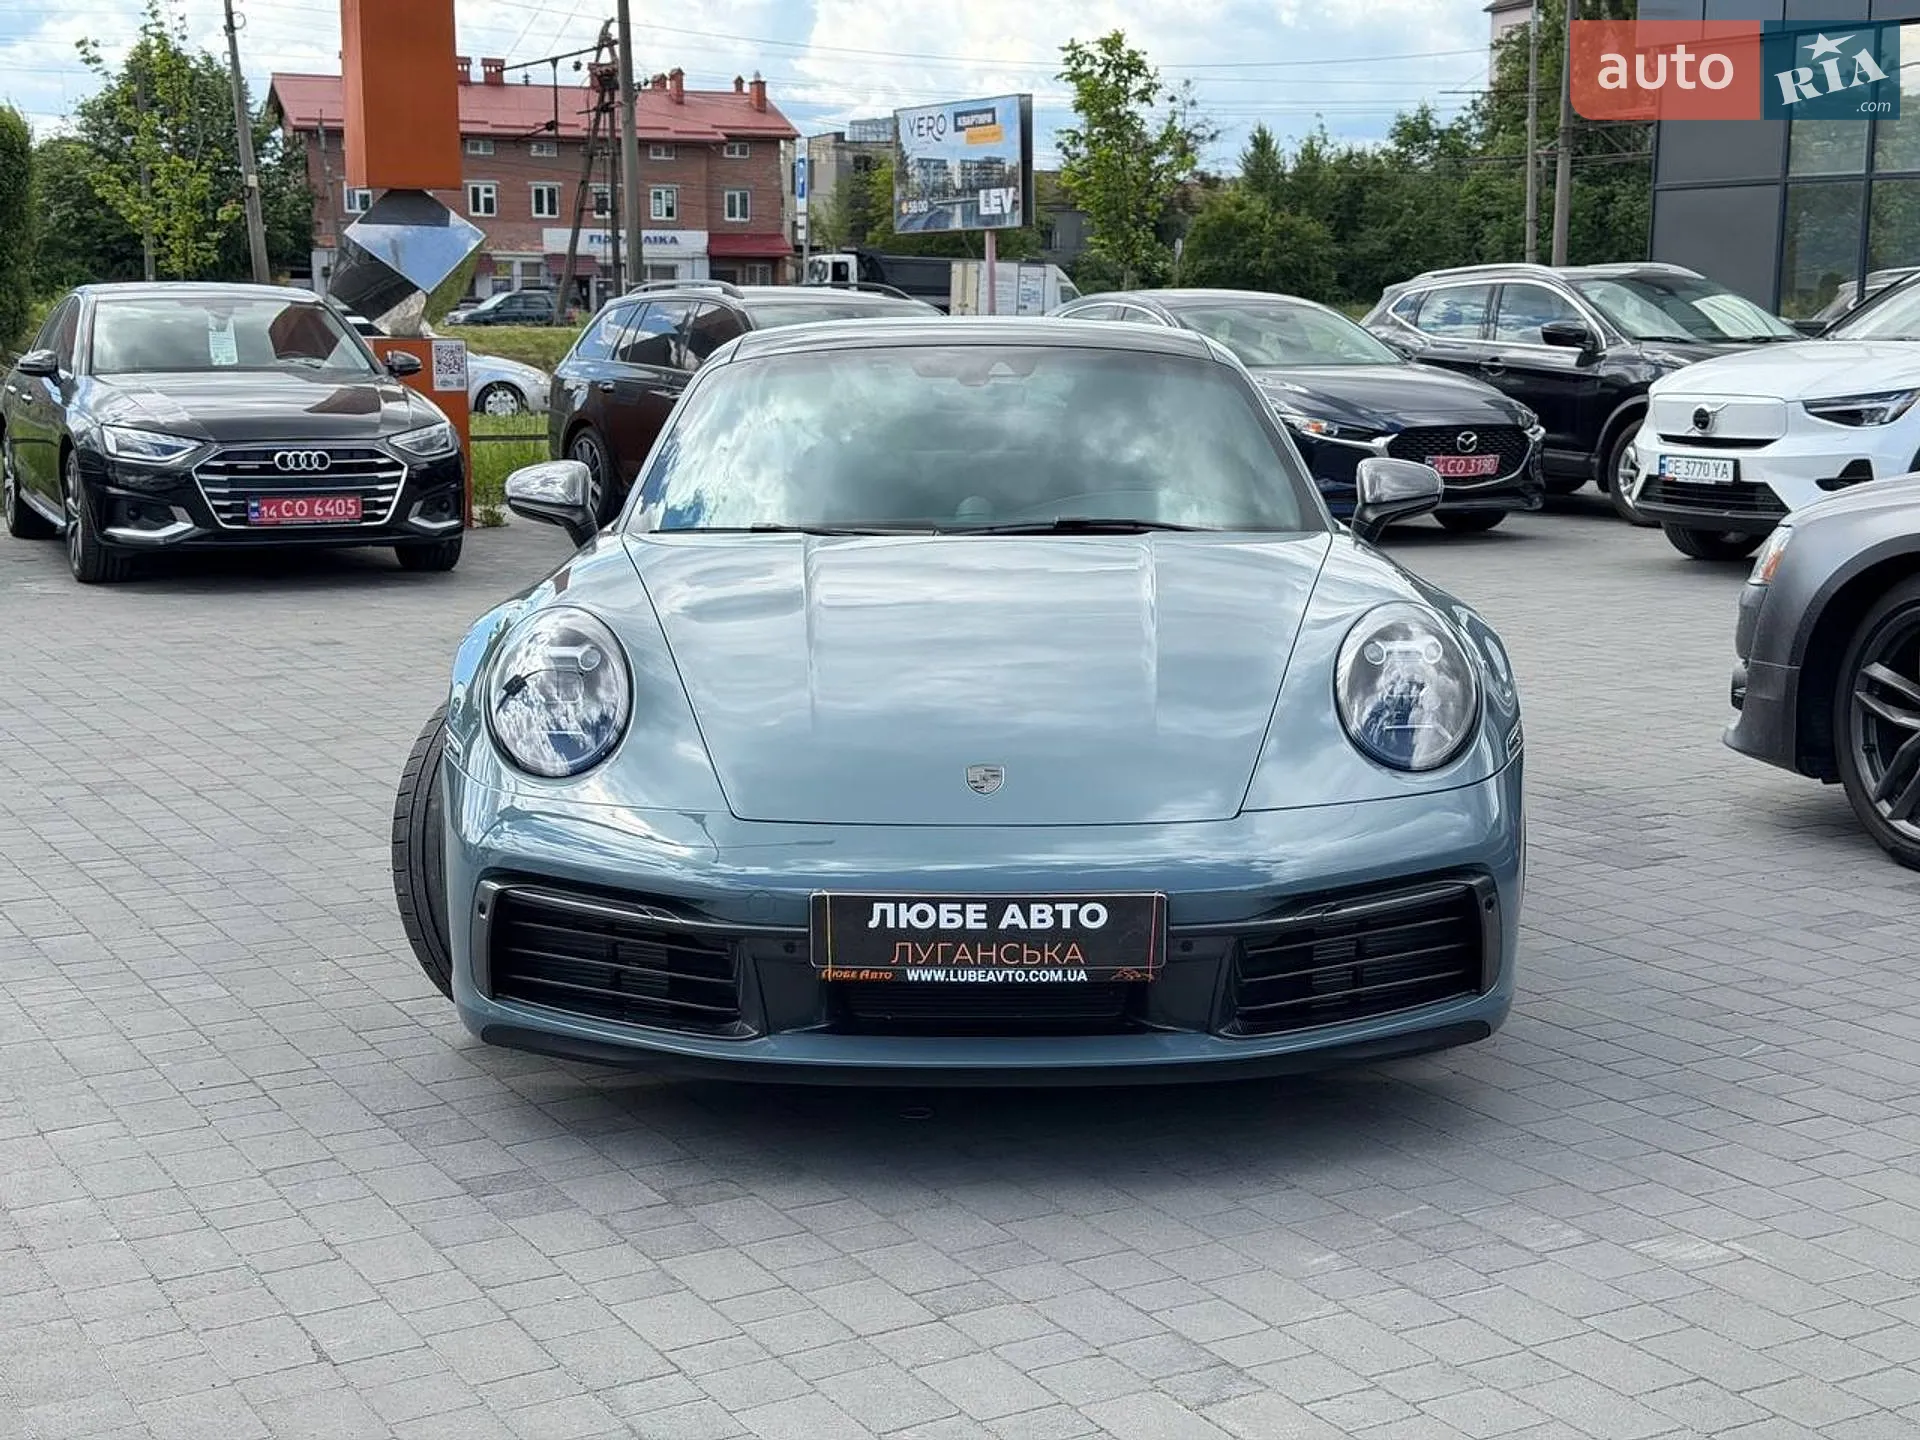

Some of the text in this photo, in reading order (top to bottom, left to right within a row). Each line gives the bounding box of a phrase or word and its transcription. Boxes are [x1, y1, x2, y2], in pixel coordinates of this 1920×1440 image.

[908, 113, 948, 142] VERO
[979, 187, 1016, 216] LEV
[1683, 460, 1710, 478] 3770
[261, 505, 277, 517] 14
[281, 500, 308, 516] CO
[314, 499, 356, 516] 6405
[868, 903, 1109, 929] ЛЮБЕ АВТО
[890, 942, 1086, 965] ЛУГАНСЬКА
[906, 969, 1088, 982] WWW.LUBEAVTO.COM.UA
